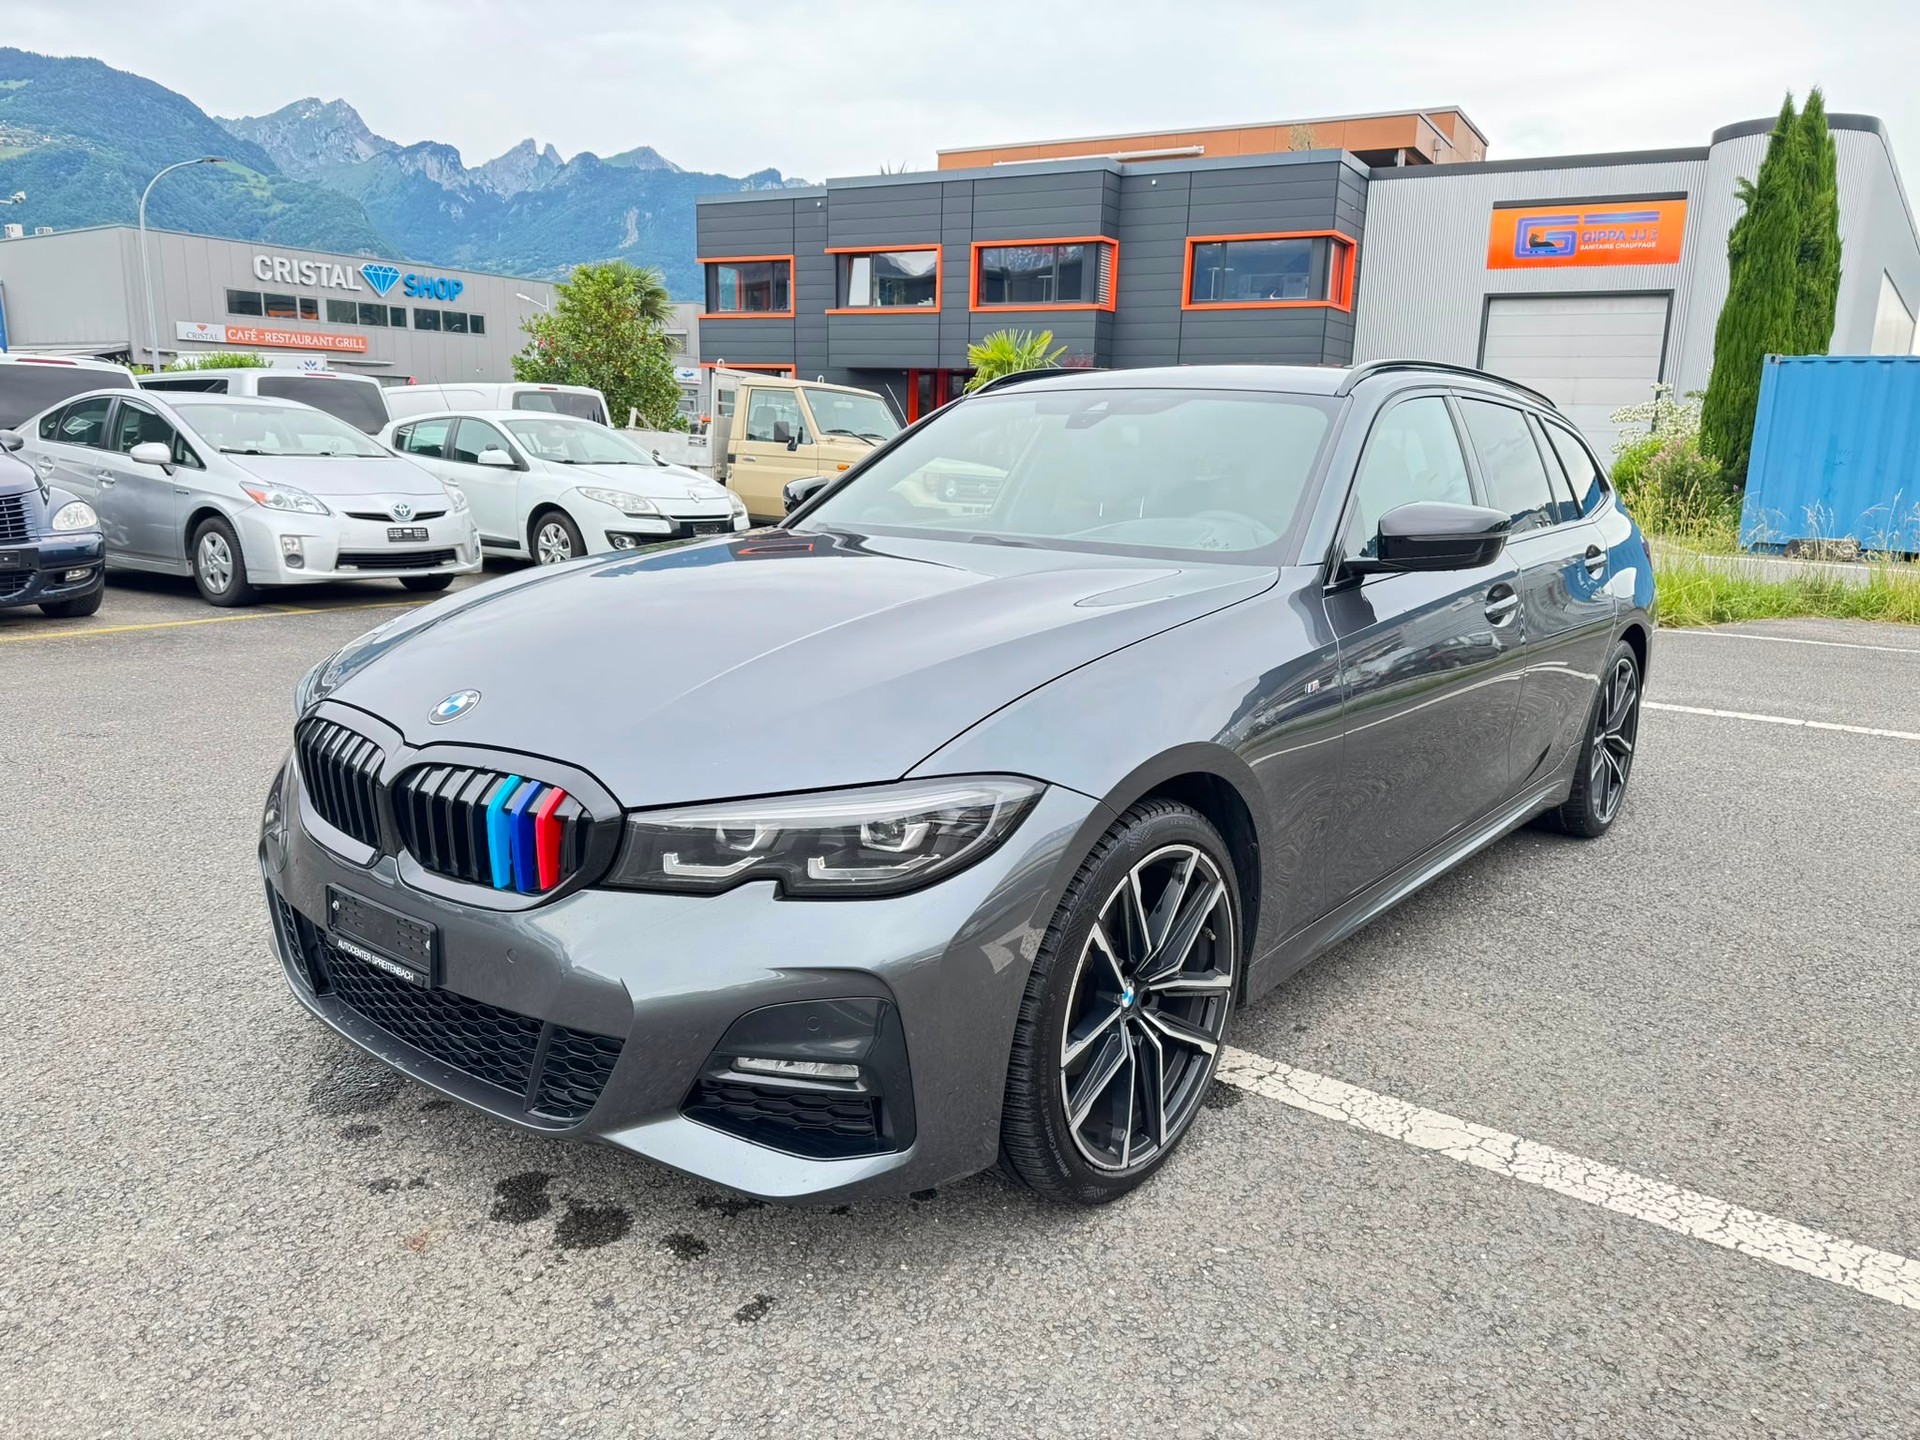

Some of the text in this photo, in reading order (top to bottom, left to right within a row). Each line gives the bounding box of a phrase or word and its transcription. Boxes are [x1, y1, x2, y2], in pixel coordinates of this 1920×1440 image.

[1580, 241, 1656, 251] SANITAIRE CHAUFFAGE
[1581, 230, 1626, 242] GIPPA
[253, 255, 464, 301] CRISTAL SHOP
[186, 331, 220, 341] CRISTAL
[227, 328, 258, 342] CAFÉ
[335, 337, 366, 349] GRILL
[338, 939, 414, 982] AUTOCENTER SPREITENBACH
[1042, 1108, 1071, 1177] WinterContact
